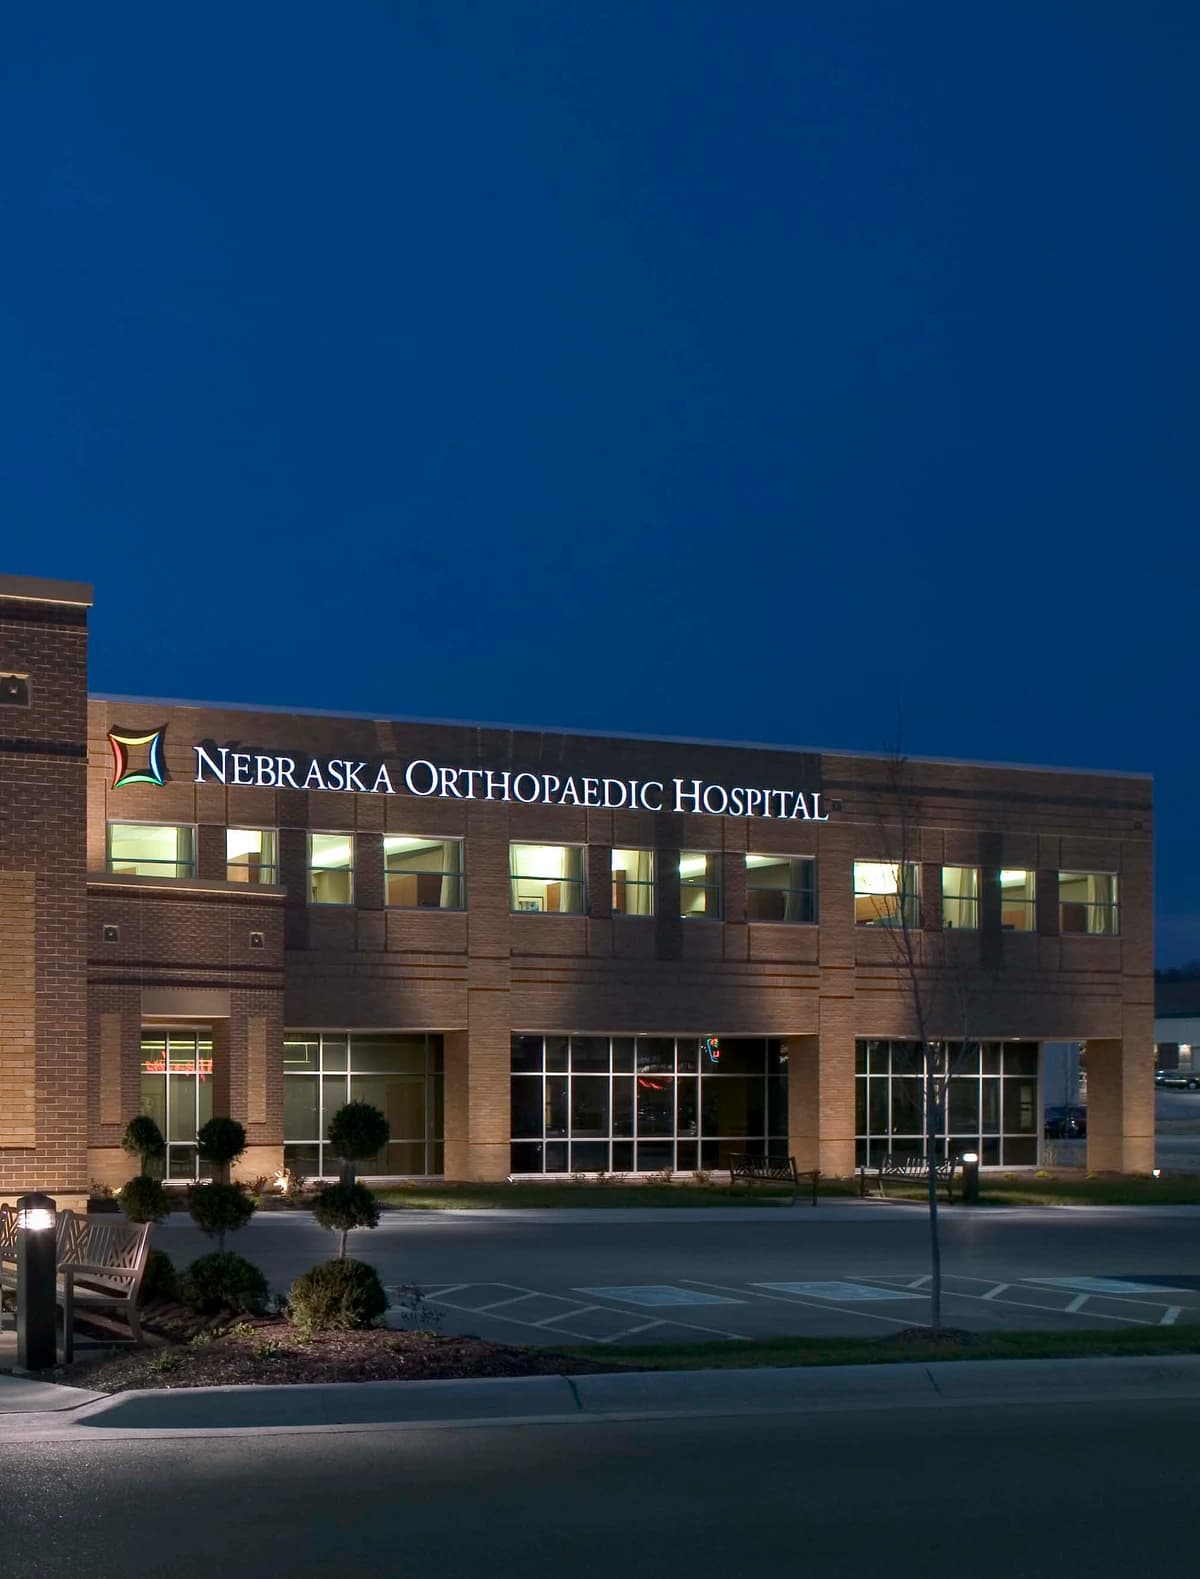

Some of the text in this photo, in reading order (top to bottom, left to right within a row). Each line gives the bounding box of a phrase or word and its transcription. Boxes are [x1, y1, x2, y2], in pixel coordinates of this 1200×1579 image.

[193, 746, 830, 821] NEBRASKA ORTHOPAEDIC HOSPITAL
